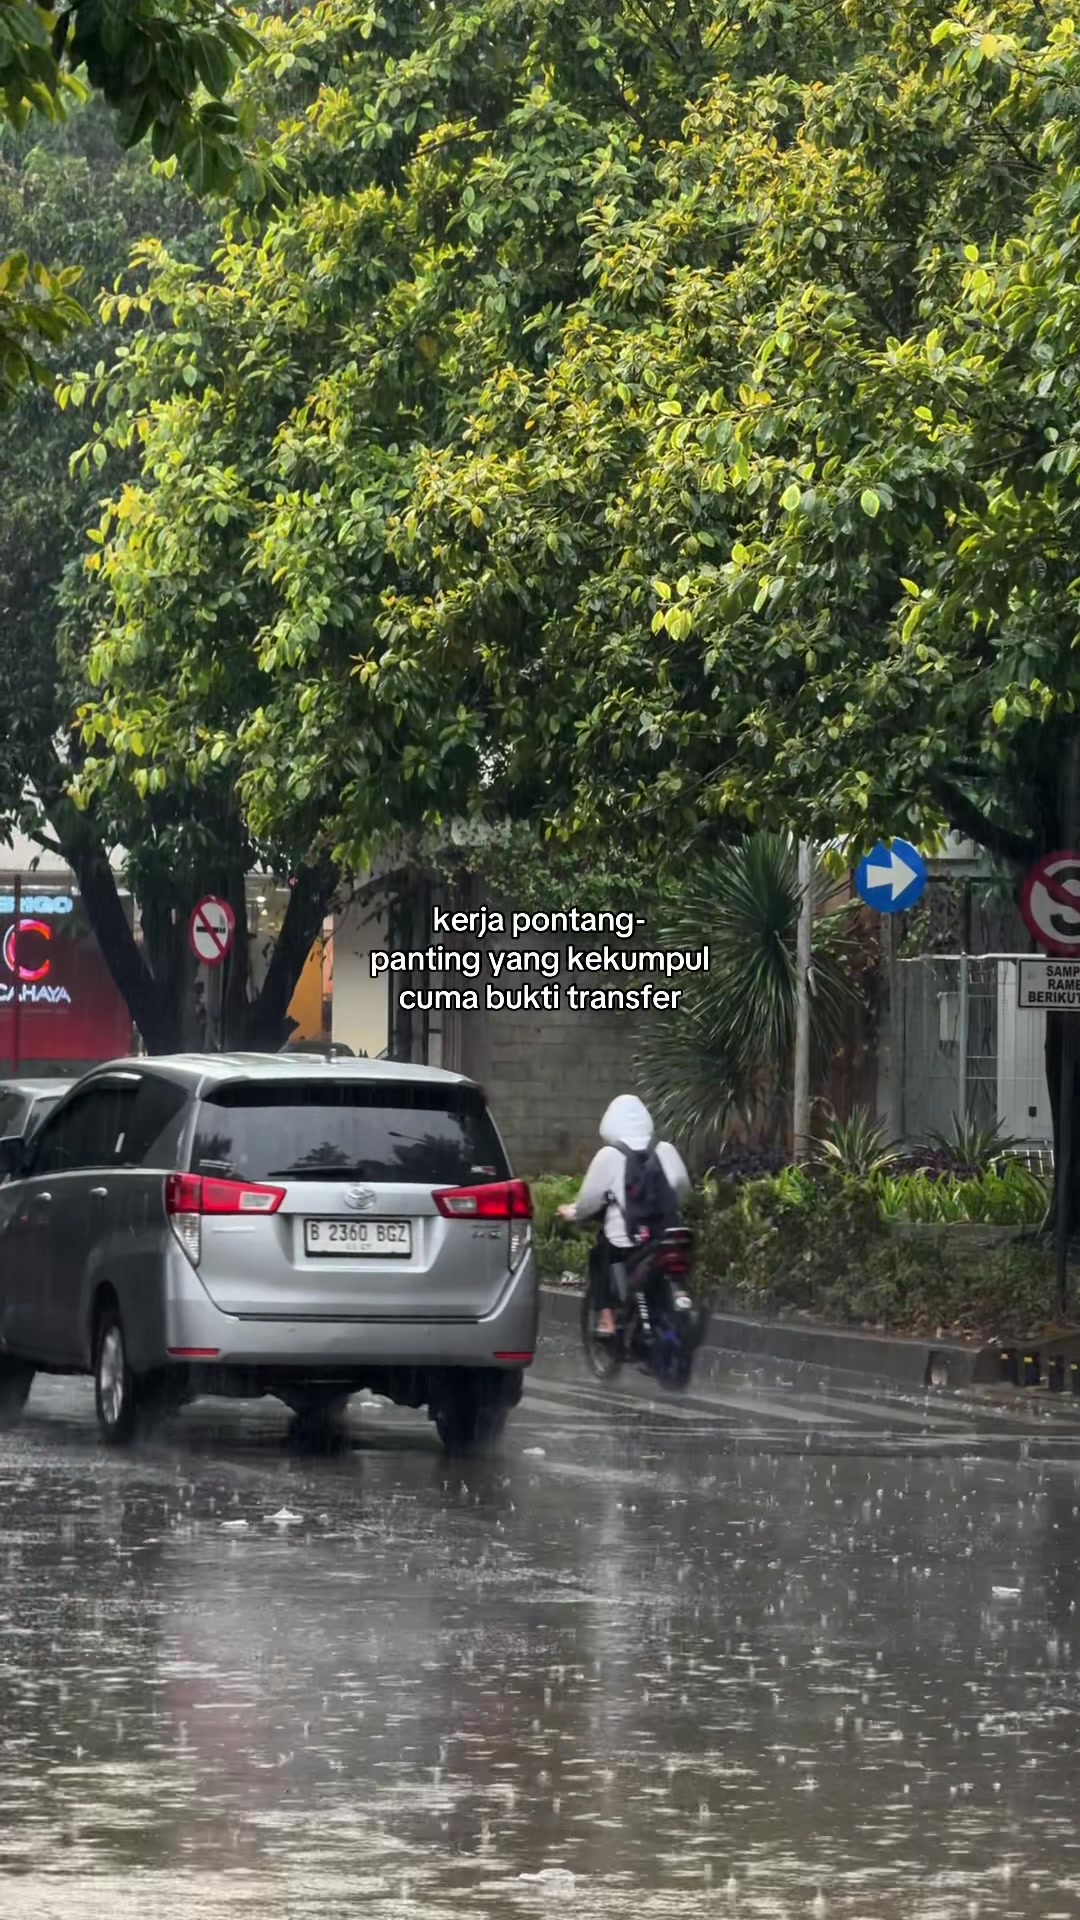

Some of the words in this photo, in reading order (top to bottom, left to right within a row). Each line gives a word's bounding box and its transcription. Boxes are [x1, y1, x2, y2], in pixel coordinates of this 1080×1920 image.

[310, 1223, 320, 1241] B
[328, 1224, 368, 1242] 2360
[377, 1225, 406, 1243] BGZ
